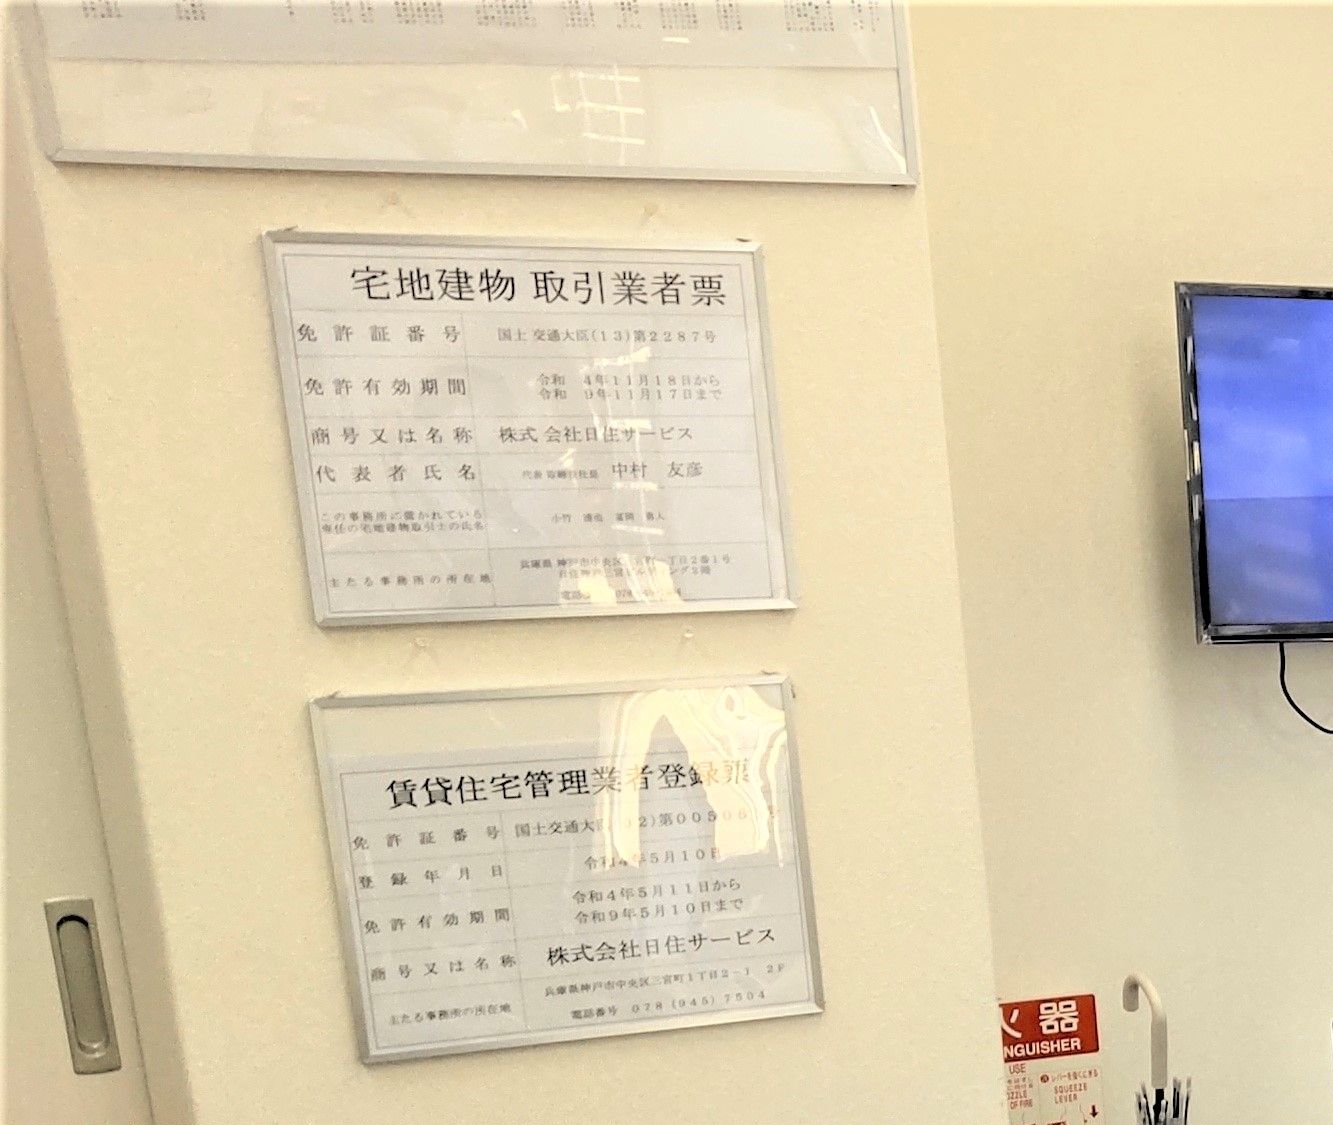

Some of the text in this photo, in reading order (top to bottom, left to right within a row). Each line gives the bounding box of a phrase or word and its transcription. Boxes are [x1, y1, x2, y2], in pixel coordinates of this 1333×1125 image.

[297, 322, 462, 343] 免許証番号
[304, 377, 467, 396] 免許有効期間
[310, 427, 473, 446] 商号又は名称
[315, 464, 476, 483] 代表者氏名
[611, 461, 648, 479] 中村
[353, 824, 500, 850] 免許証番号
[358, 864, 503, 889] 登録年月日
[364, 907, 510, 935] 免許有効期間
[546, 928, 775, 967] 株式会社日住サービス
[370, 954, 516, 983] 商号又は名称
[1003, 1037, 1081, 1059] NGUISHER
[1008, 1062, 1026, 1075] USE
[1054, 1082, 1088, 1095] SQUEEZE
[1054, 1093, 1078, 1105] LEVER
